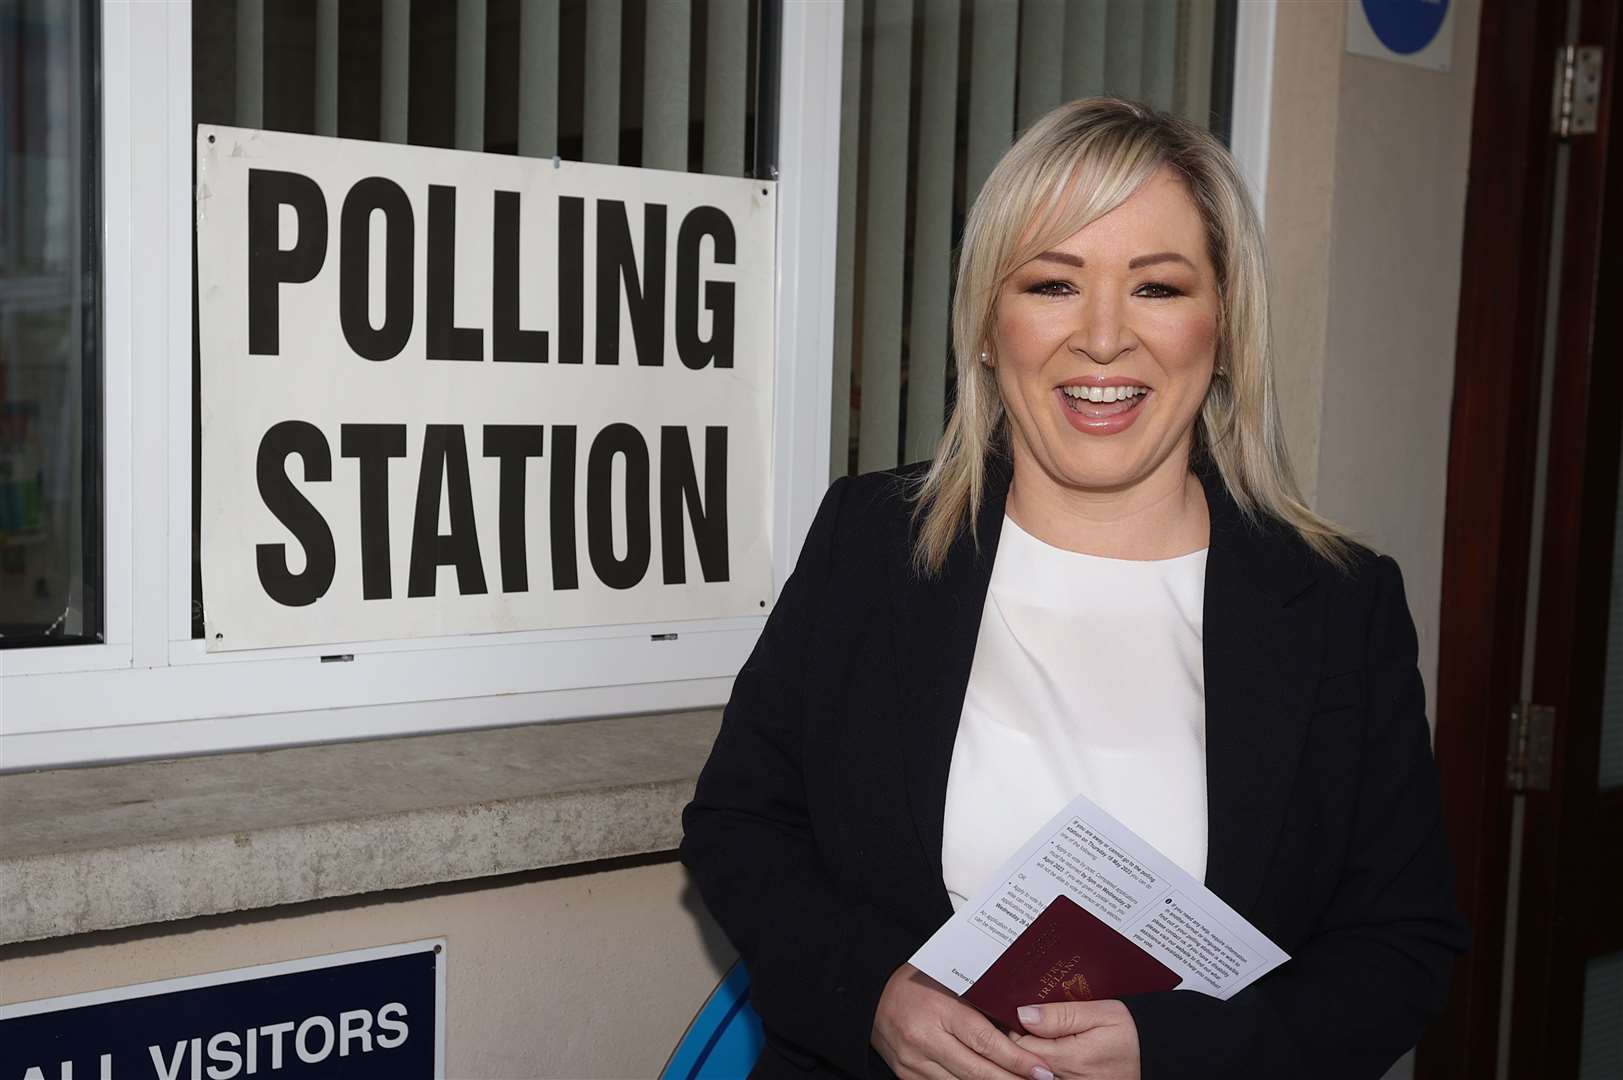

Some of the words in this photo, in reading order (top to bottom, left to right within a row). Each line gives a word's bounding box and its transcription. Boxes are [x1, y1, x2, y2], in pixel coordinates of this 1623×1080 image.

[248, 167, 736, 370] POLLING
[255, 420, 730, 607] STATION
[1067, 827, 1082, 839] station
[1087, 841, 1107, 858] Thursday
[1112, 859, 1122, 868] May
[1092, 835, 1104, 846] away
[1108, 847, 1125, 859] cannot
[1139, 871, 1156, 883] polling
[1145, 923, 1160, 934] please
[1160, 933, 1170, 941] visit
[1175, 945, 1191, 958] website
[1195, 959, 1205, 968] find
[1210, 972, 1222, 980] what
[1151, 918, 1166, 929] please
[1165, 928, 1182, 940] contact
[1198, 952, 1209, 962] have
[1211, 962, 1230, 978] disability
[1159, 913, 1169, 921] find
[1176, 927, 1188, 936] your
[1185, 934, 1202, 947] polling
[1200, 945, 1215, 957] station
[1218, 959, 1240, 976] accessible
[1169, 912, 1186, 925] another
[1184, 923, 1200, 935] format
[1202, 937, 1221, 952] language
[1225, 955, 1237, 964] wish
[1182, 912, 1194, 921] need
[1192, 920, 1201, 928] any
[1210, 934, 1225, 946] require
[1037, 955, 1081, 999] IRELAND
[148, 1002, 409, 1080] VISITORS
